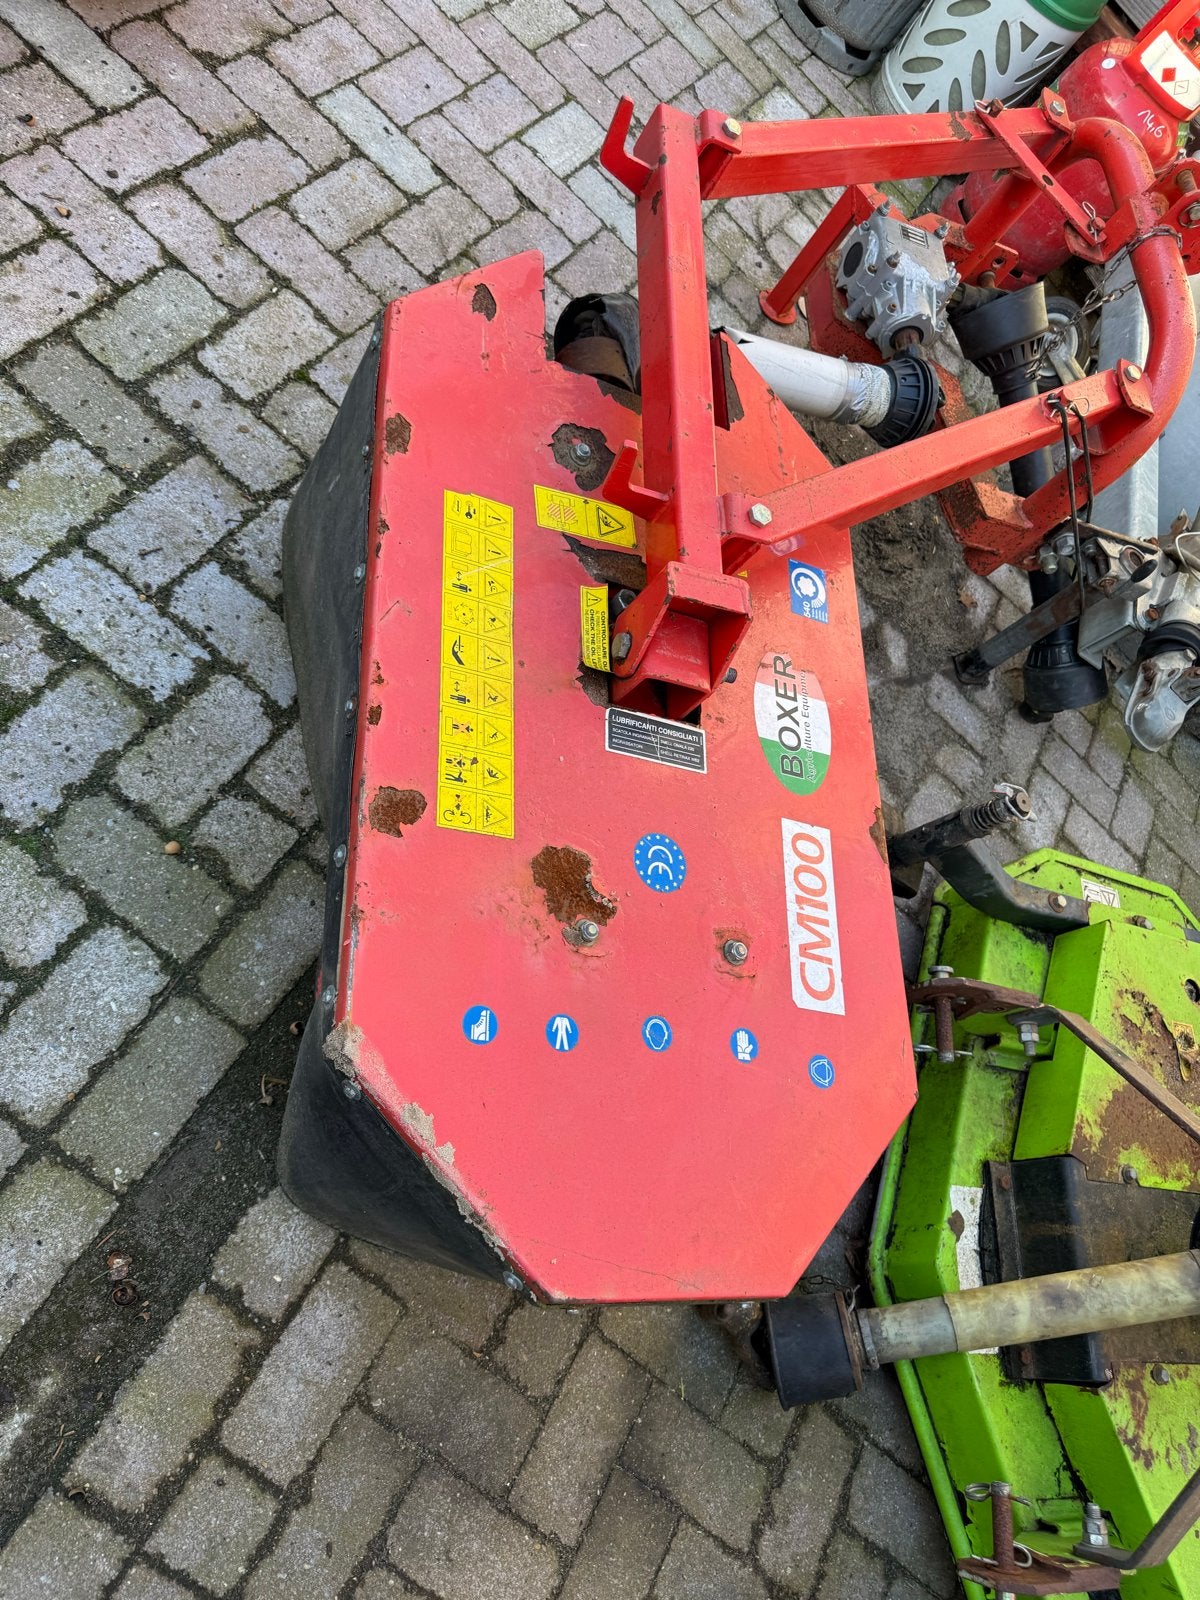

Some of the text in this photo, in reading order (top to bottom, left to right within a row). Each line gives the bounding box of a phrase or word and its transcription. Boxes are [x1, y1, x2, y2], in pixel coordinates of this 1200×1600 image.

[1137, 109, 1166, 138] 14,6
[612, 714, 657, 732] LUBRIFICANTI
[658, 727, 699, 743] CONSIGLIATI
[773, 655, 805, 779] BOXER
[803, 721, 817, 783] Agriculture
[647, 845, 673, 880] CE
[791, 832, 836, 1001] CM100
